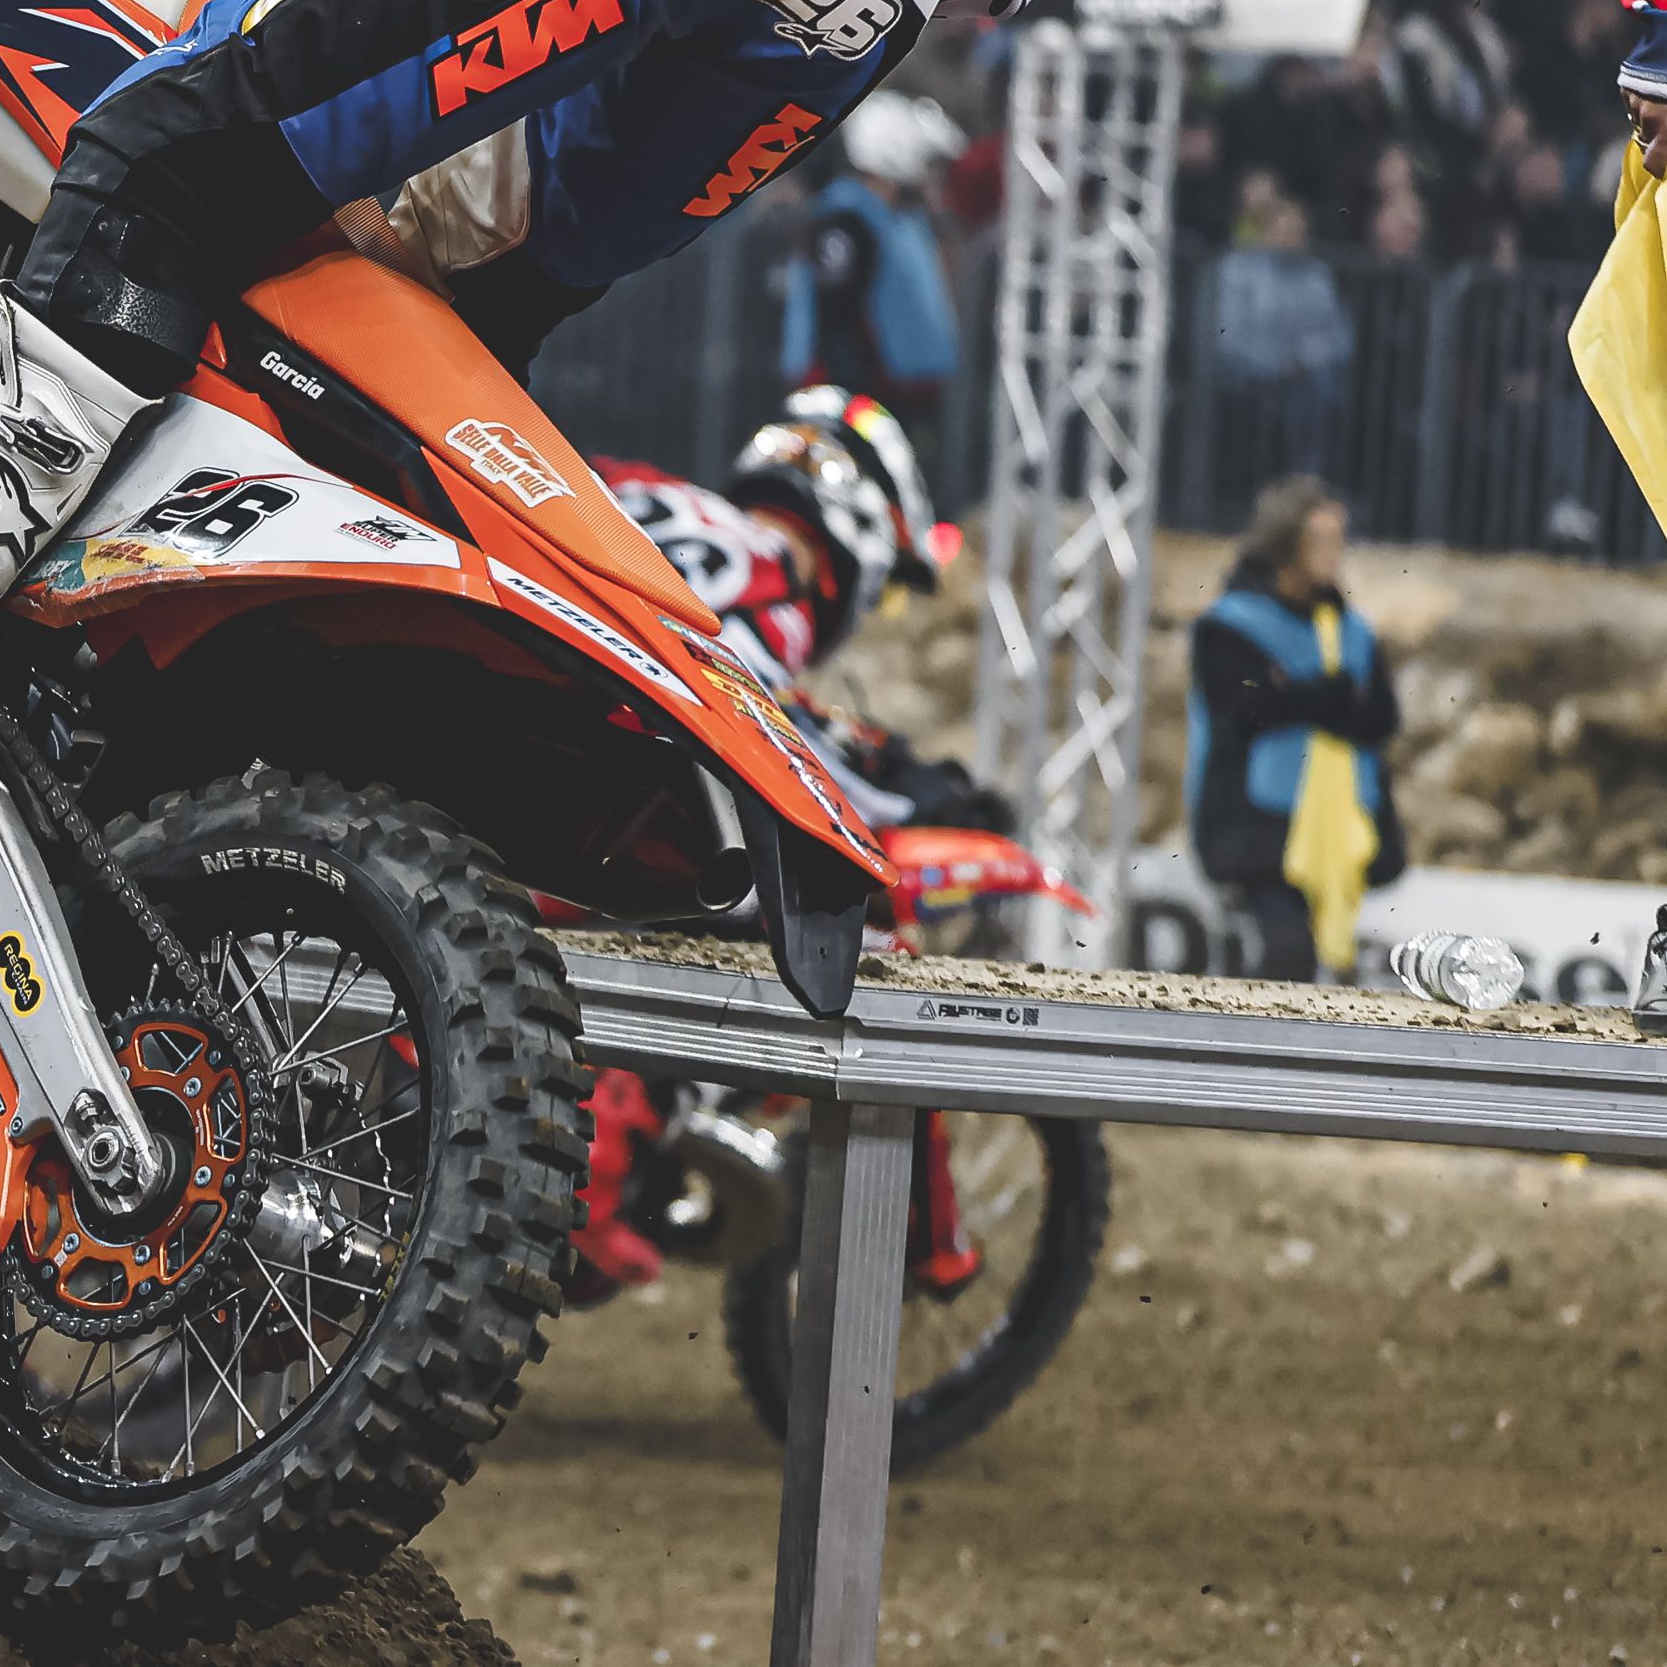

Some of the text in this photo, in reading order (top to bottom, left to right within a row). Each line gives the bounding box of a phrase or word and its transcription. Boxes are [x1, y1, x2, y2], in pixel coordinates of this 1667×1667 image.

[259, 350, 326, 400] Garcia
[122, 467, 299, 560] 26
[339, 522, 397, 550] ENDURO
[506, 577, 644, 661] METZELER
[200, 846, 347, 895] METZELER
[4, 943, 33, 1001] REGINA
